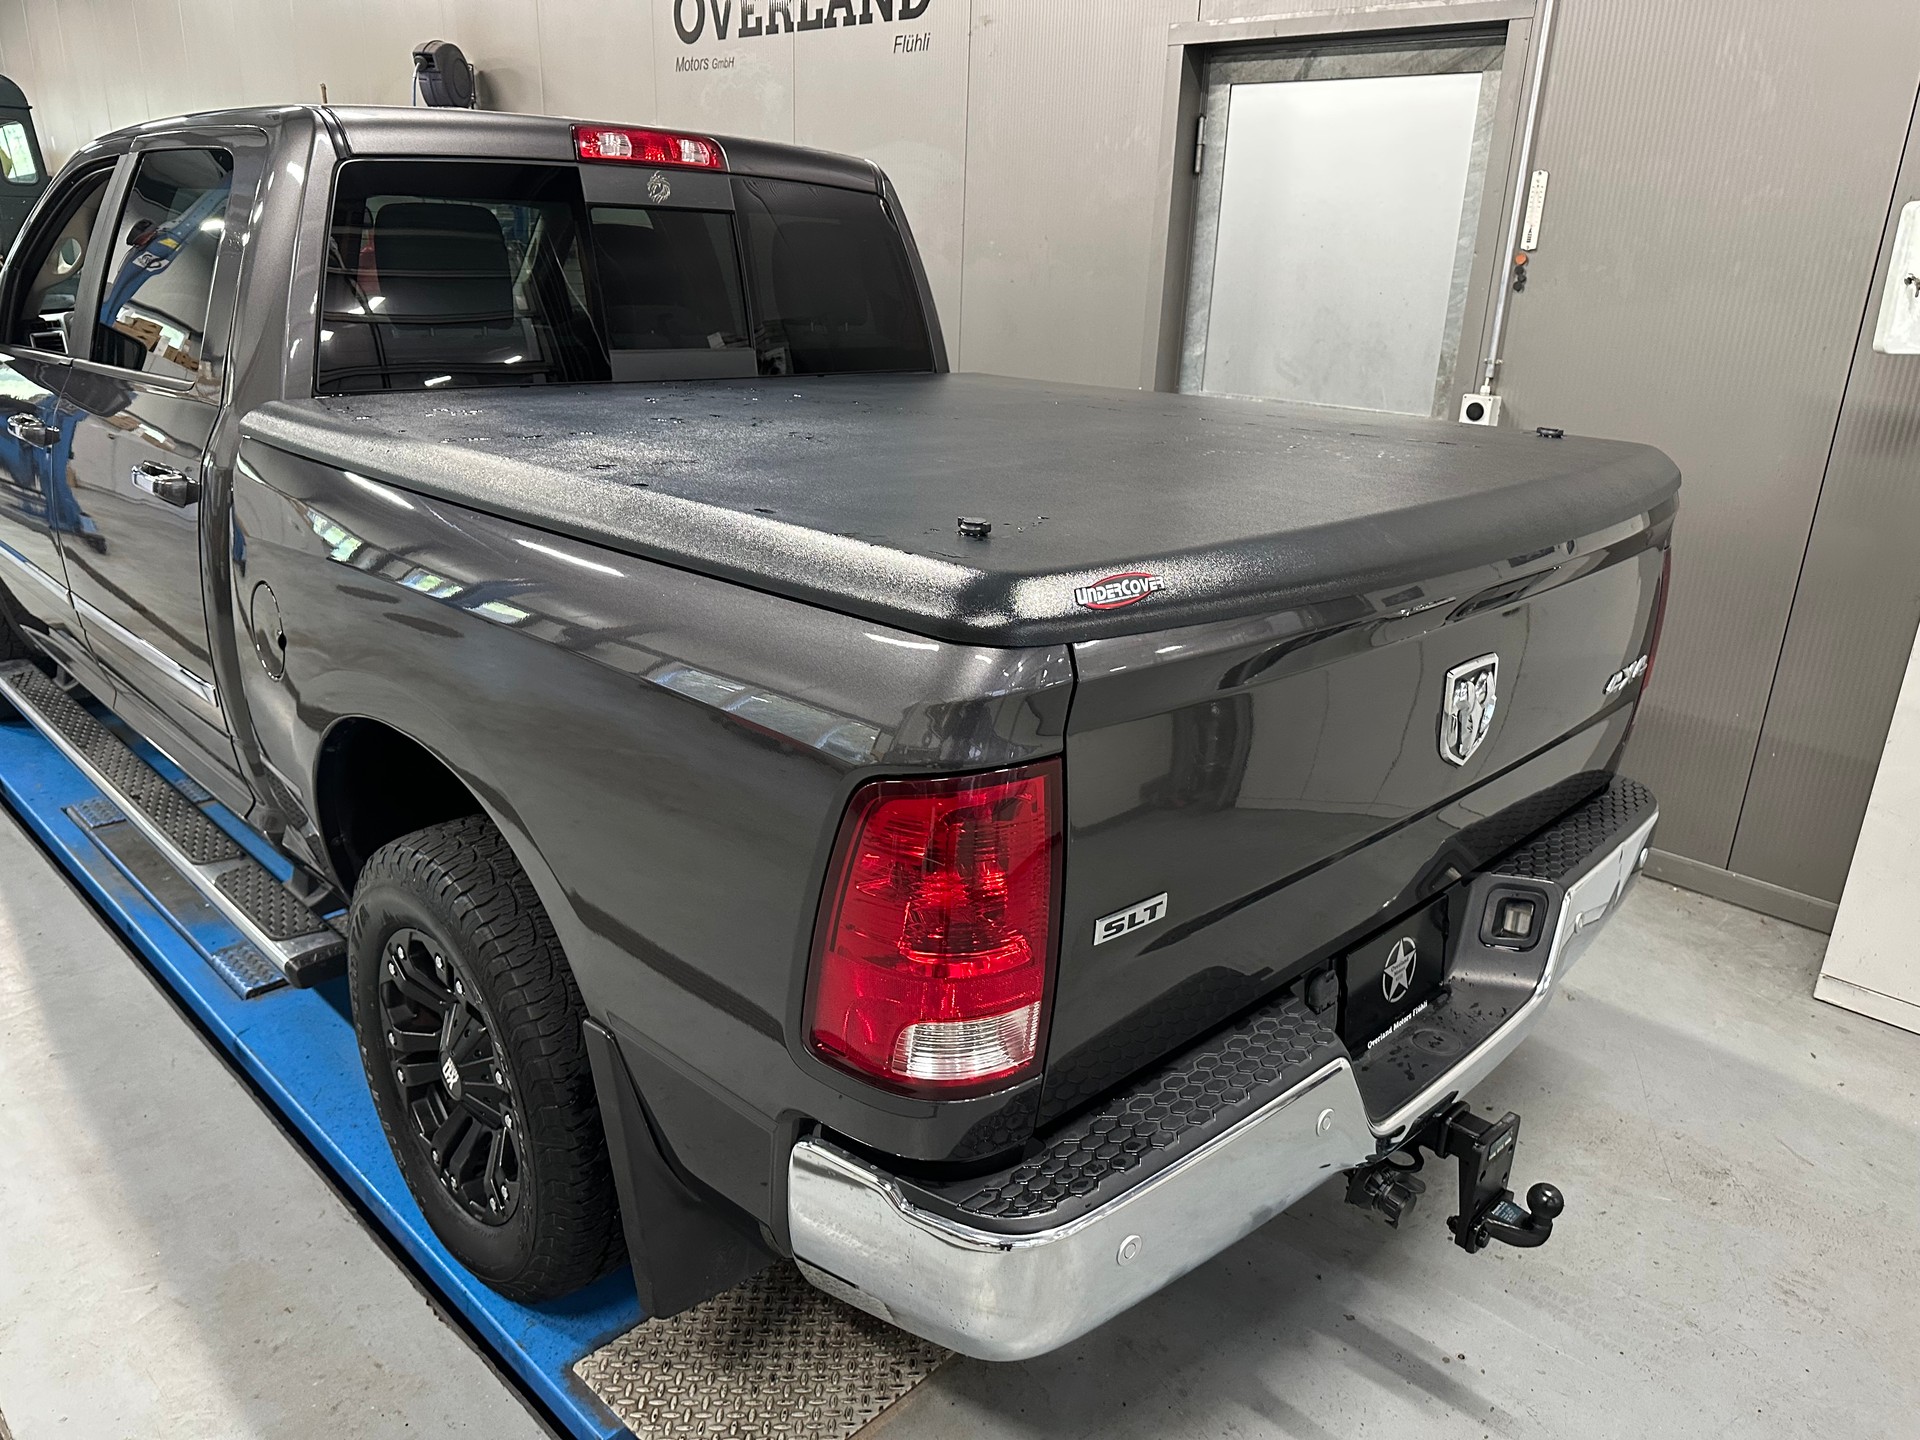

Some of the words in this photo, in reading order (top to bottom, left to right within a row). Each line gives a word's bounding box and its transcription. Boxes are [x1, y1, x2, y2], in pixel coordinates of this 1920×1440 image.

[893, 32, 931, 54] Flühli
[675, 56, 709, 72] Motors
[711, 56, 735, 70] GmbH
[1075, 576, 1165, 606] UNDERCOVER
[1102, 900, 1164, 940] SLT
